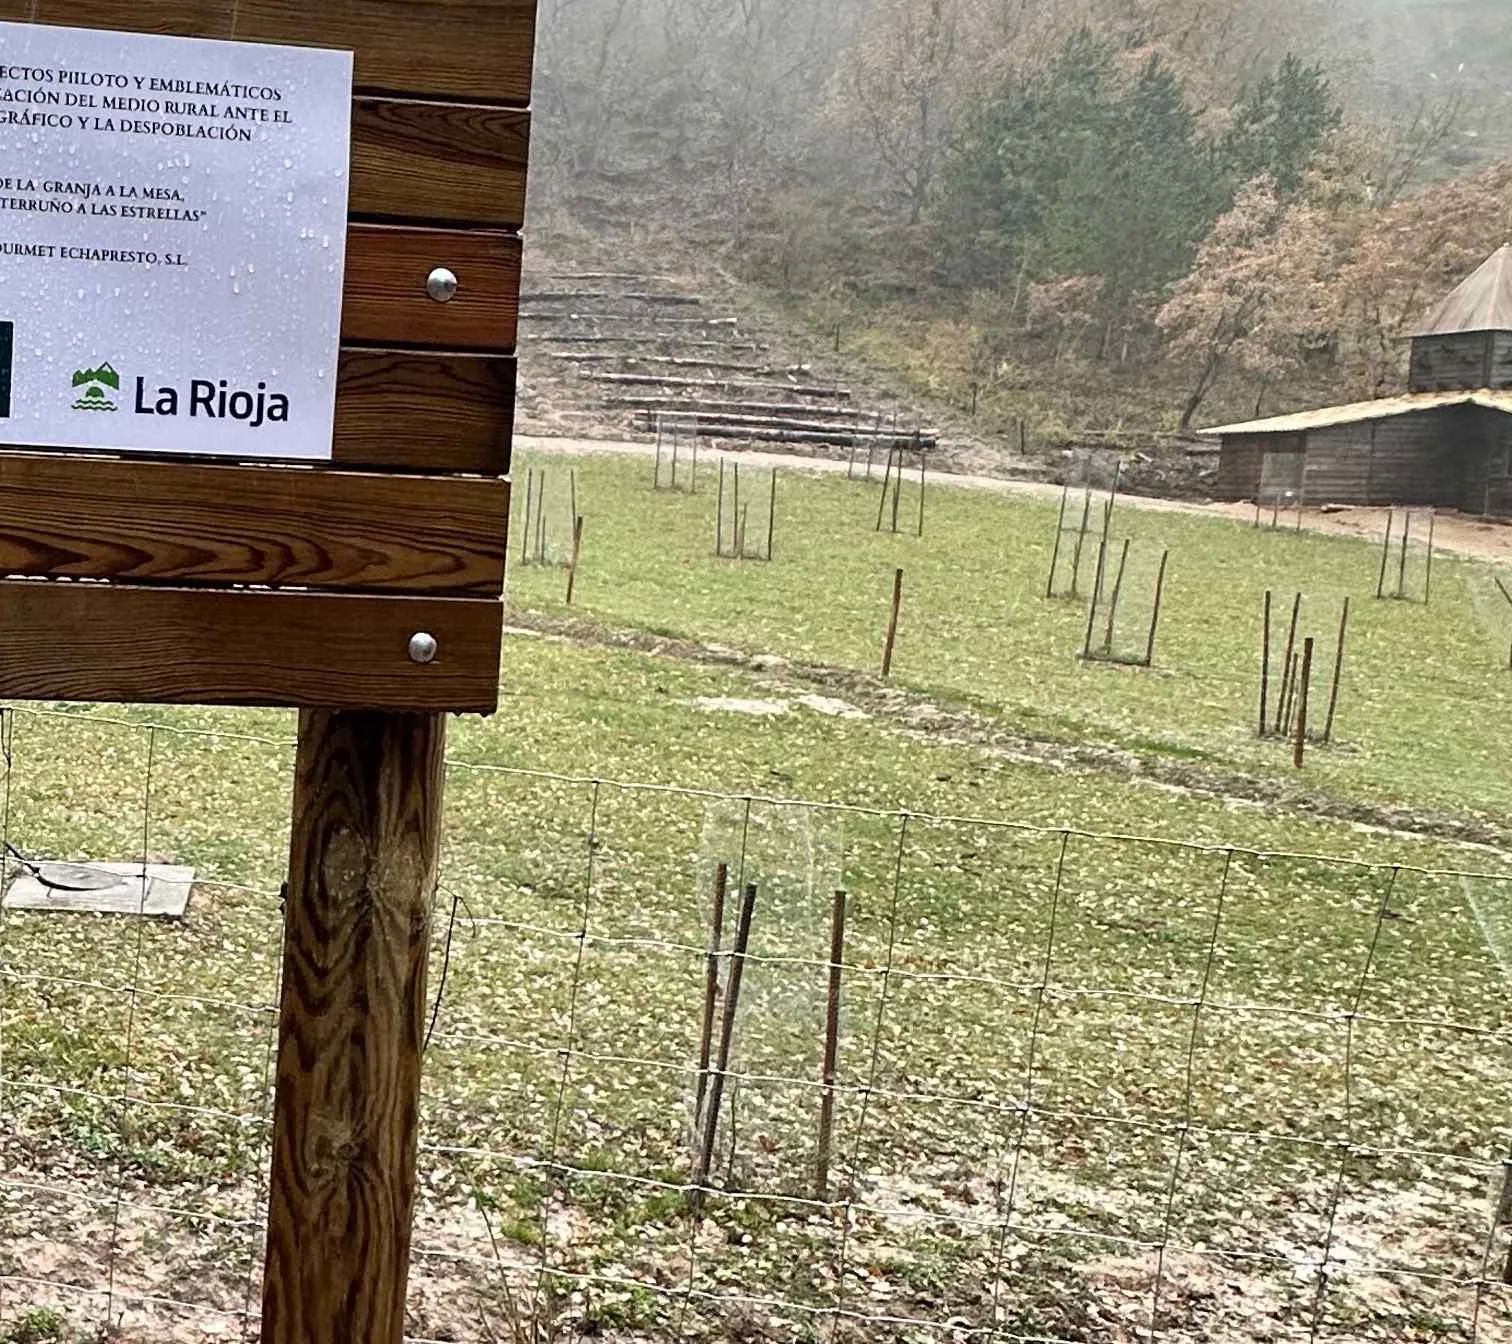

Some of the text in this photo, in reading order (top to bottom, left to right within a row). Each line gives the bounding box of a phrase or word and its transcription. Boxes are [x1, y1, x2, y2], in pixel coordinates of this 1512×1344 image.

[134, 75, 146, 90] Y
[148, 79, 283, 102] EMBLEMÁTICOS
[64, 91, 98, 108] DEL
[102, 95, 160, 113] MEDIO
[164, 100, 220, 118] RURAL
[223, 105, 269, 123] ANTE
[273, 109, 293, 124] EL
[77, 116, 90, 130] Y
[93, 117, 115, 132] LA
[119, 119, 252, 142] DESPOBLACIÓN
[16, 178, 36, 192] LA
[42, 180, 102, 199] GRANJA
[105, 184, 116, 197] A
[119, 184, 138, 199] LA
[76, 202, 88, 215] A
[90, 203, 118, 217] LAS
[134, 376, 290, 428] La Rioja
